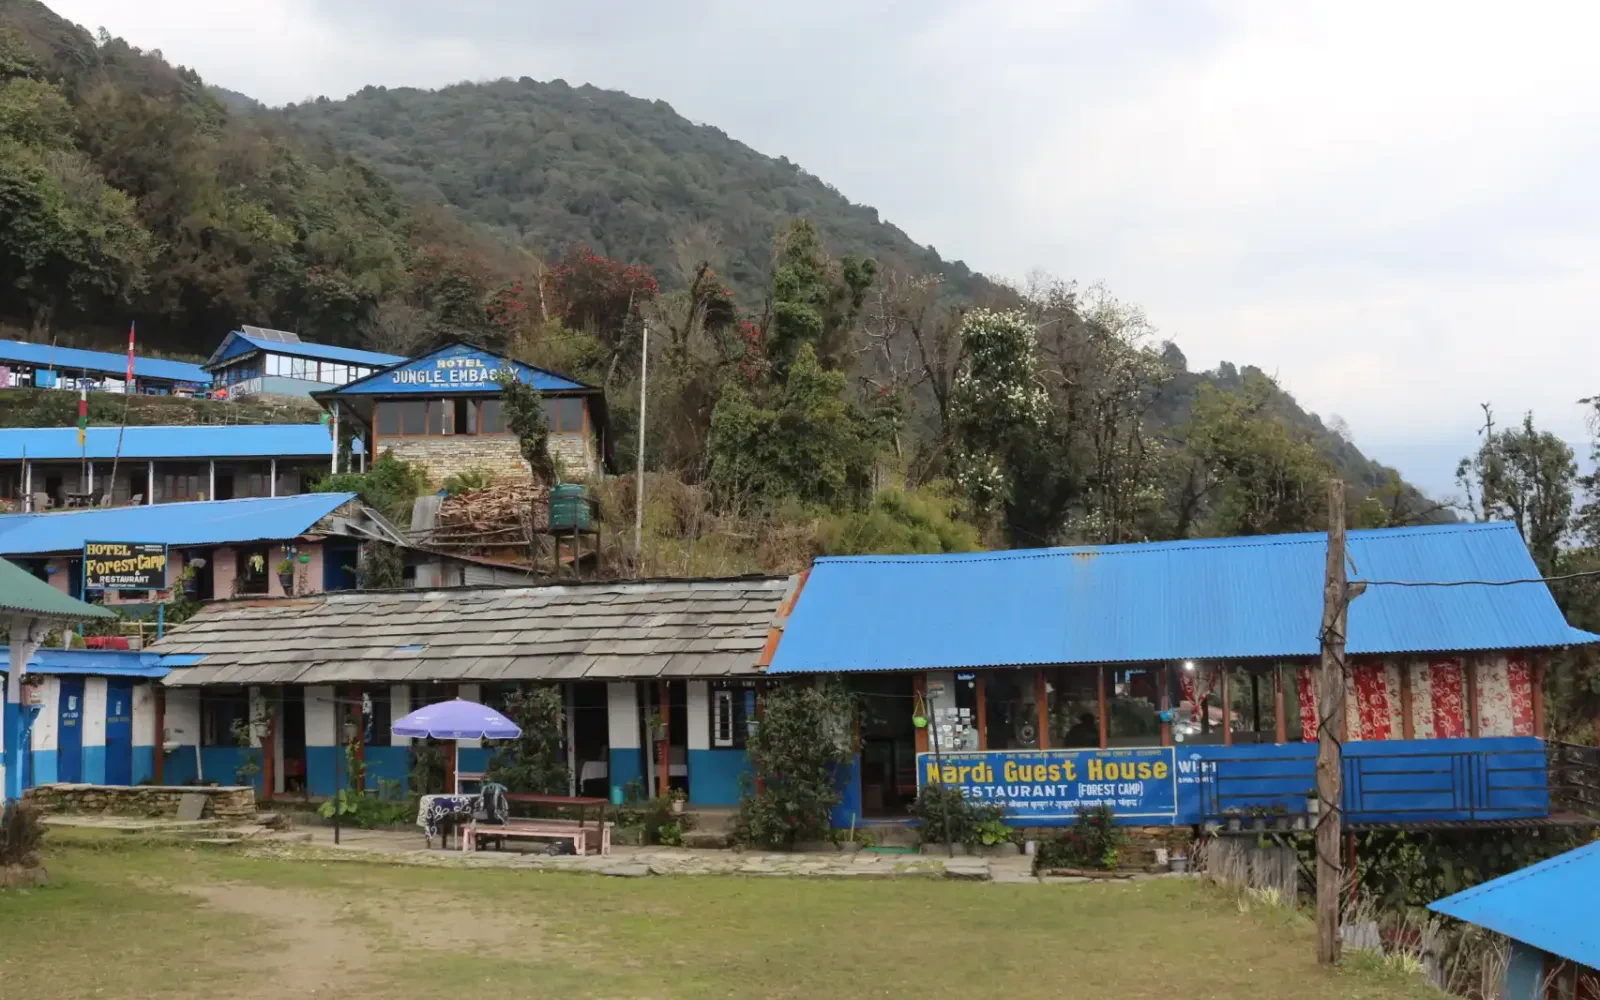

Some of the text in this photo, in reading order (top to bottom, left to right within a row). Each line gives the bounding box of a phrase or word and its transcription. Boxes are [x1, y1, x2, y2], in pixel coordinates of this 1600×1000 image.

[436, 359, 485, 369] HOTEL
[392, 370, 446, 385] JUNGLE
[86, 543, 132, 556] HOTEL
[137, 554, 166, 572] Camp
[99, 575, 150, 583] RESTAURANT
[926, 758, 1168, 784] Mardi Guest House
[948, 784, 1068, 798] ESTAURANT
